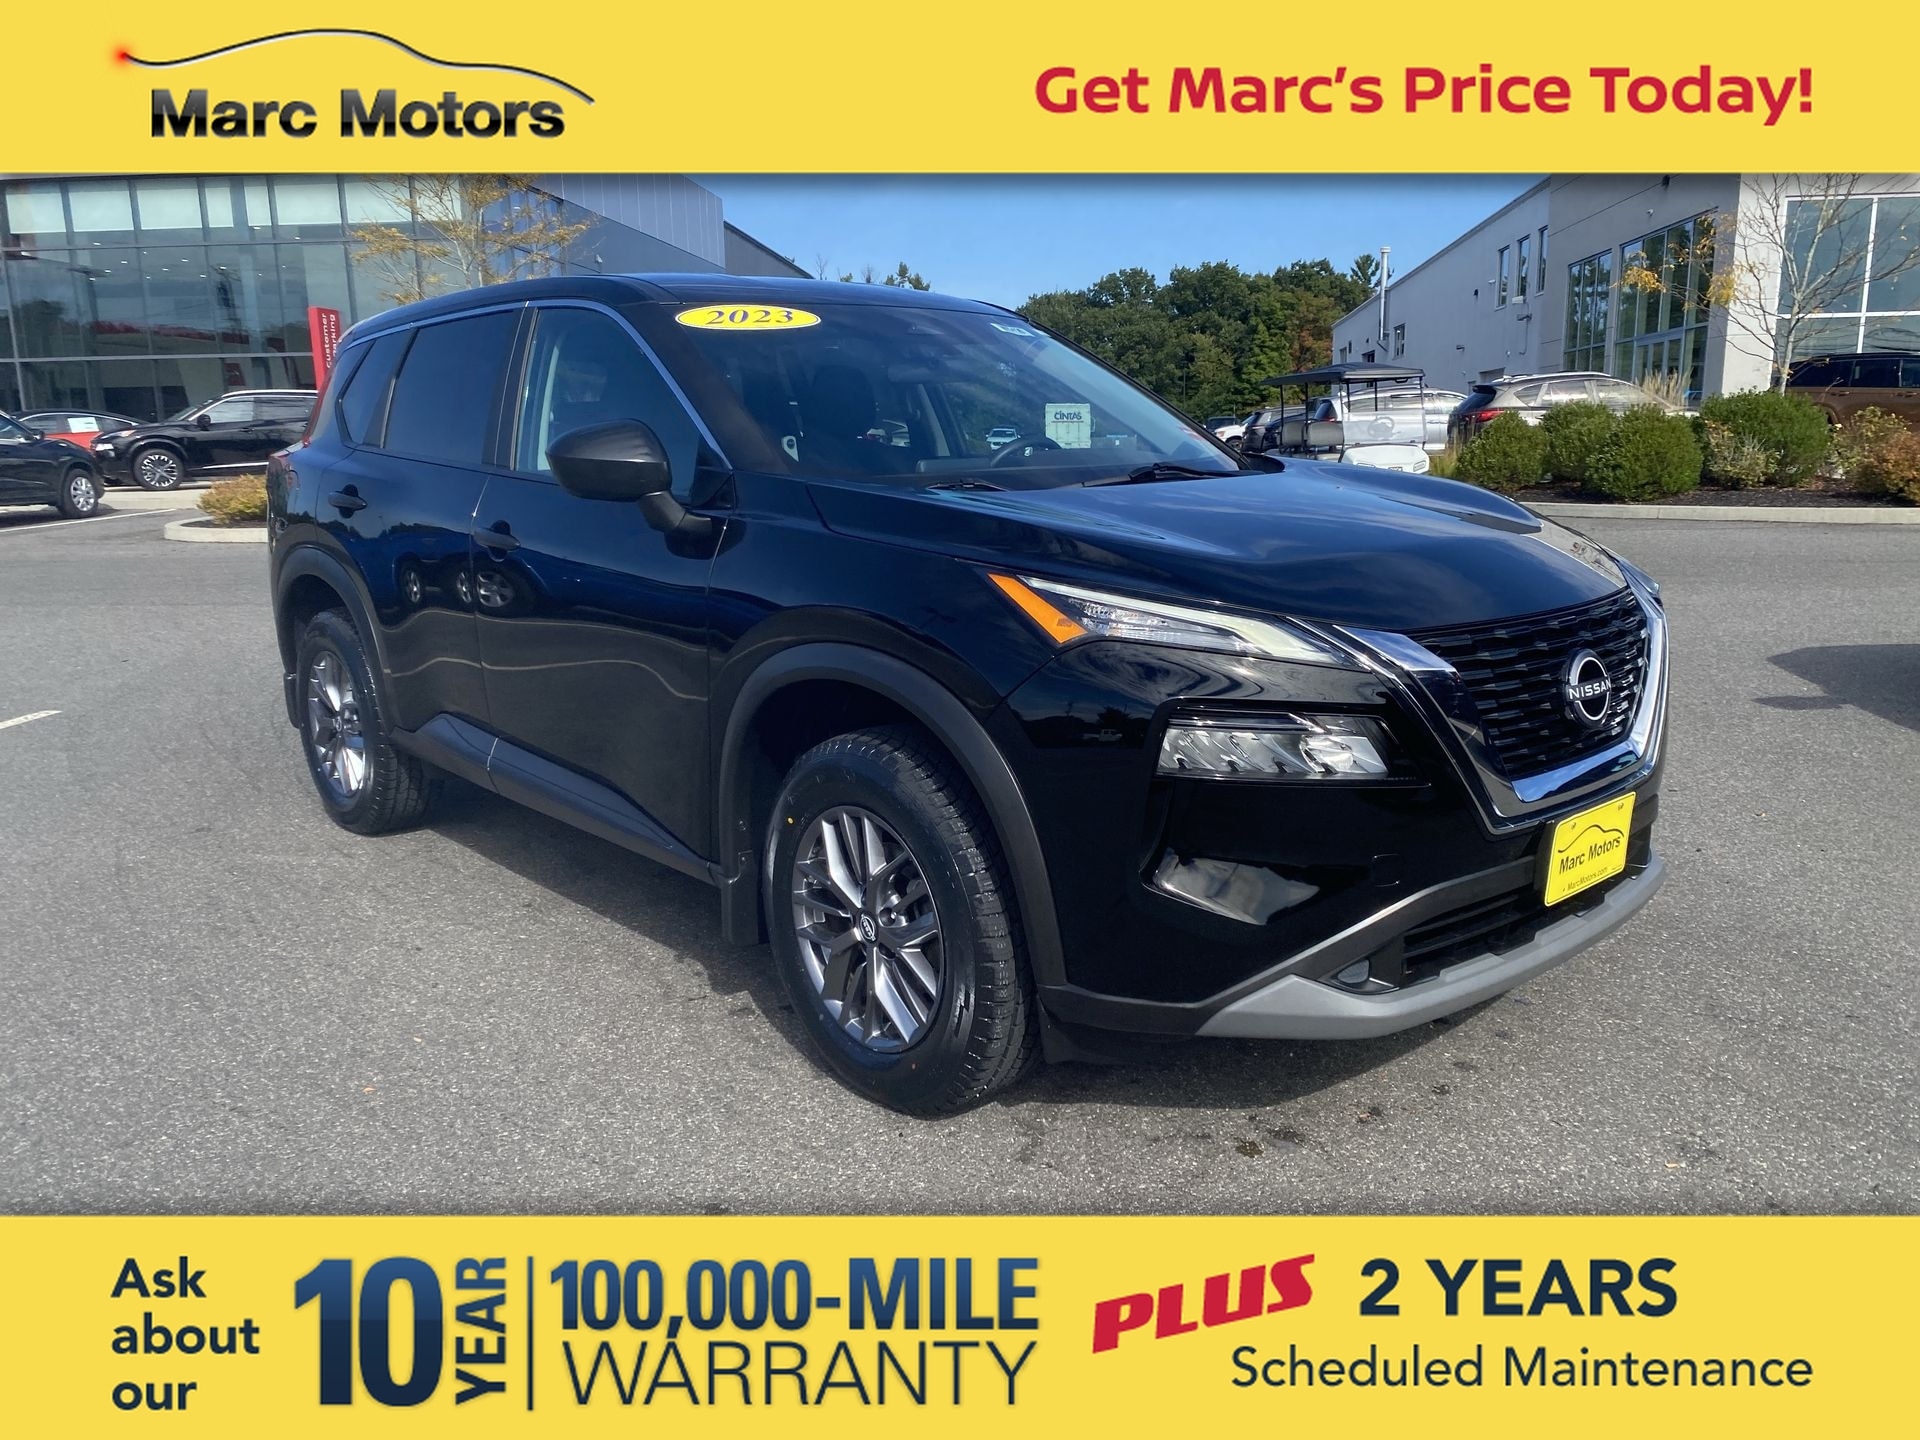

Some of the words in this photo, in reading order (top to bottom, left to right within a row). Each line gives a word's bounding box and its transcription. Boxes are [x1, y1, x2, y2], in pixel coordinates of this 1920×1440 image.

[706, 310, 793, 324] 2023
[322, 313, 332, 368] Customer
[1054, 411, 1082, 421] CINTAS
[1569, 679, 1611, 699] NISSAN
[1559, 852, 1585, 875] Marc
[1588, 836, 1621, 861] Motors
[1567, 867, 1608, 891] MarcMotors.com
